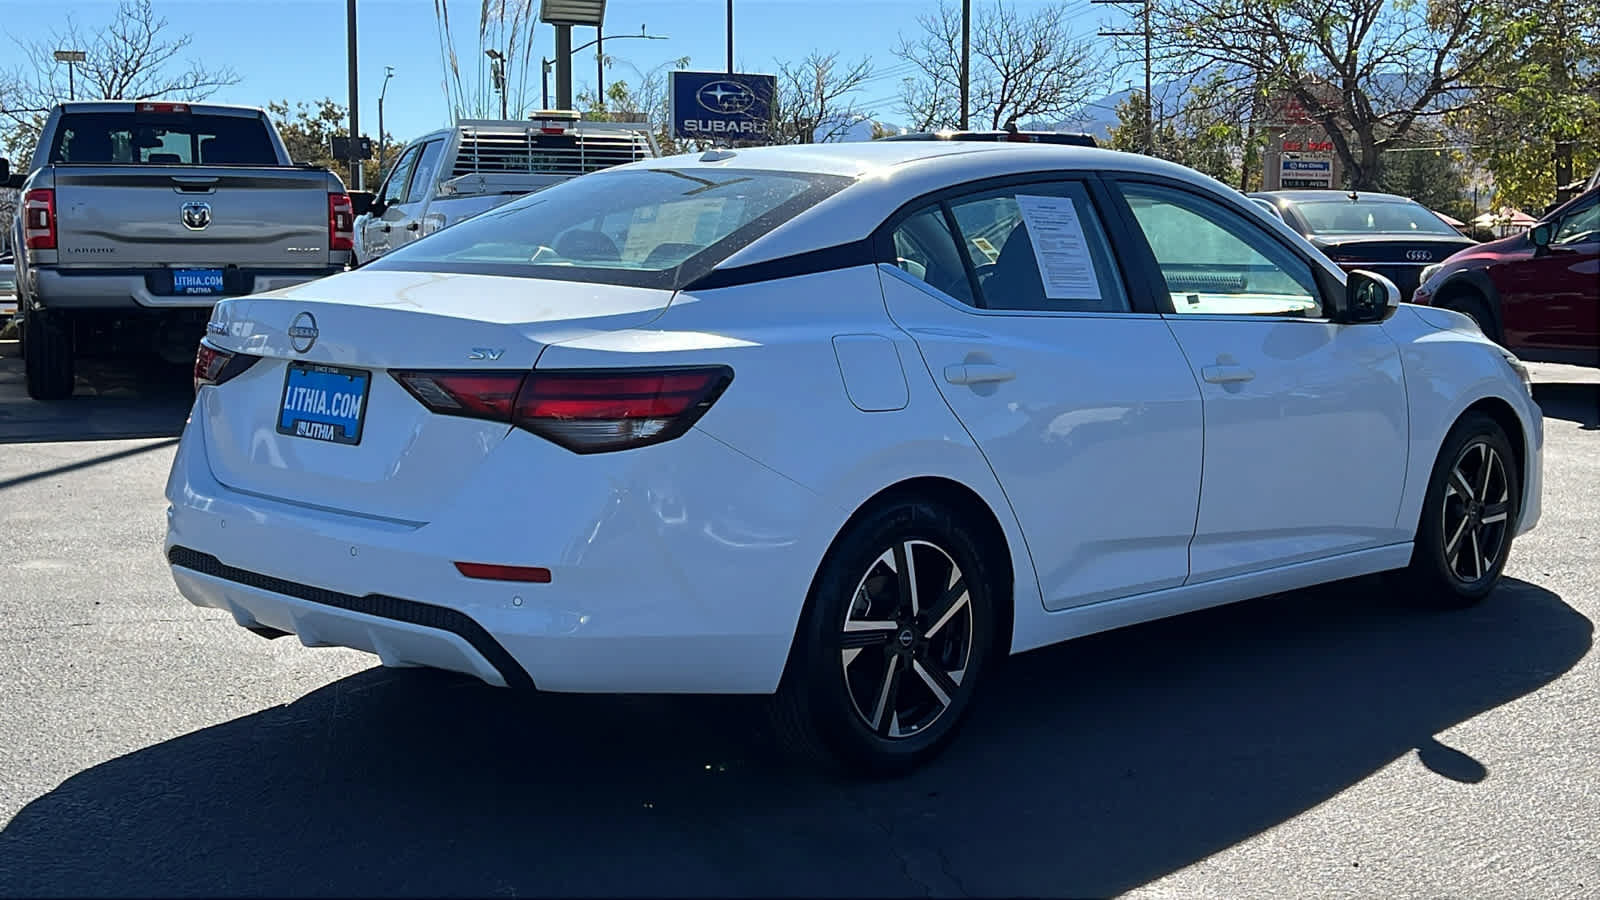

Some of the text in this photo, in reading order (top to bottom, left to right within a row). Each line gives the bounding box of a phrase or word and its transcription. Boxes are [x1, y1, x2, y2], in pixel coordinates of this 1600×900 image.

[683, 119, 766, 134] SUBARU
[174, 276, 223, 286] LITHIA.COM
[467, 347, 505, 361] SV
[284, 386, 363, 420] LITHIA.COM
[305, 421, 335, 441] LITHIA
